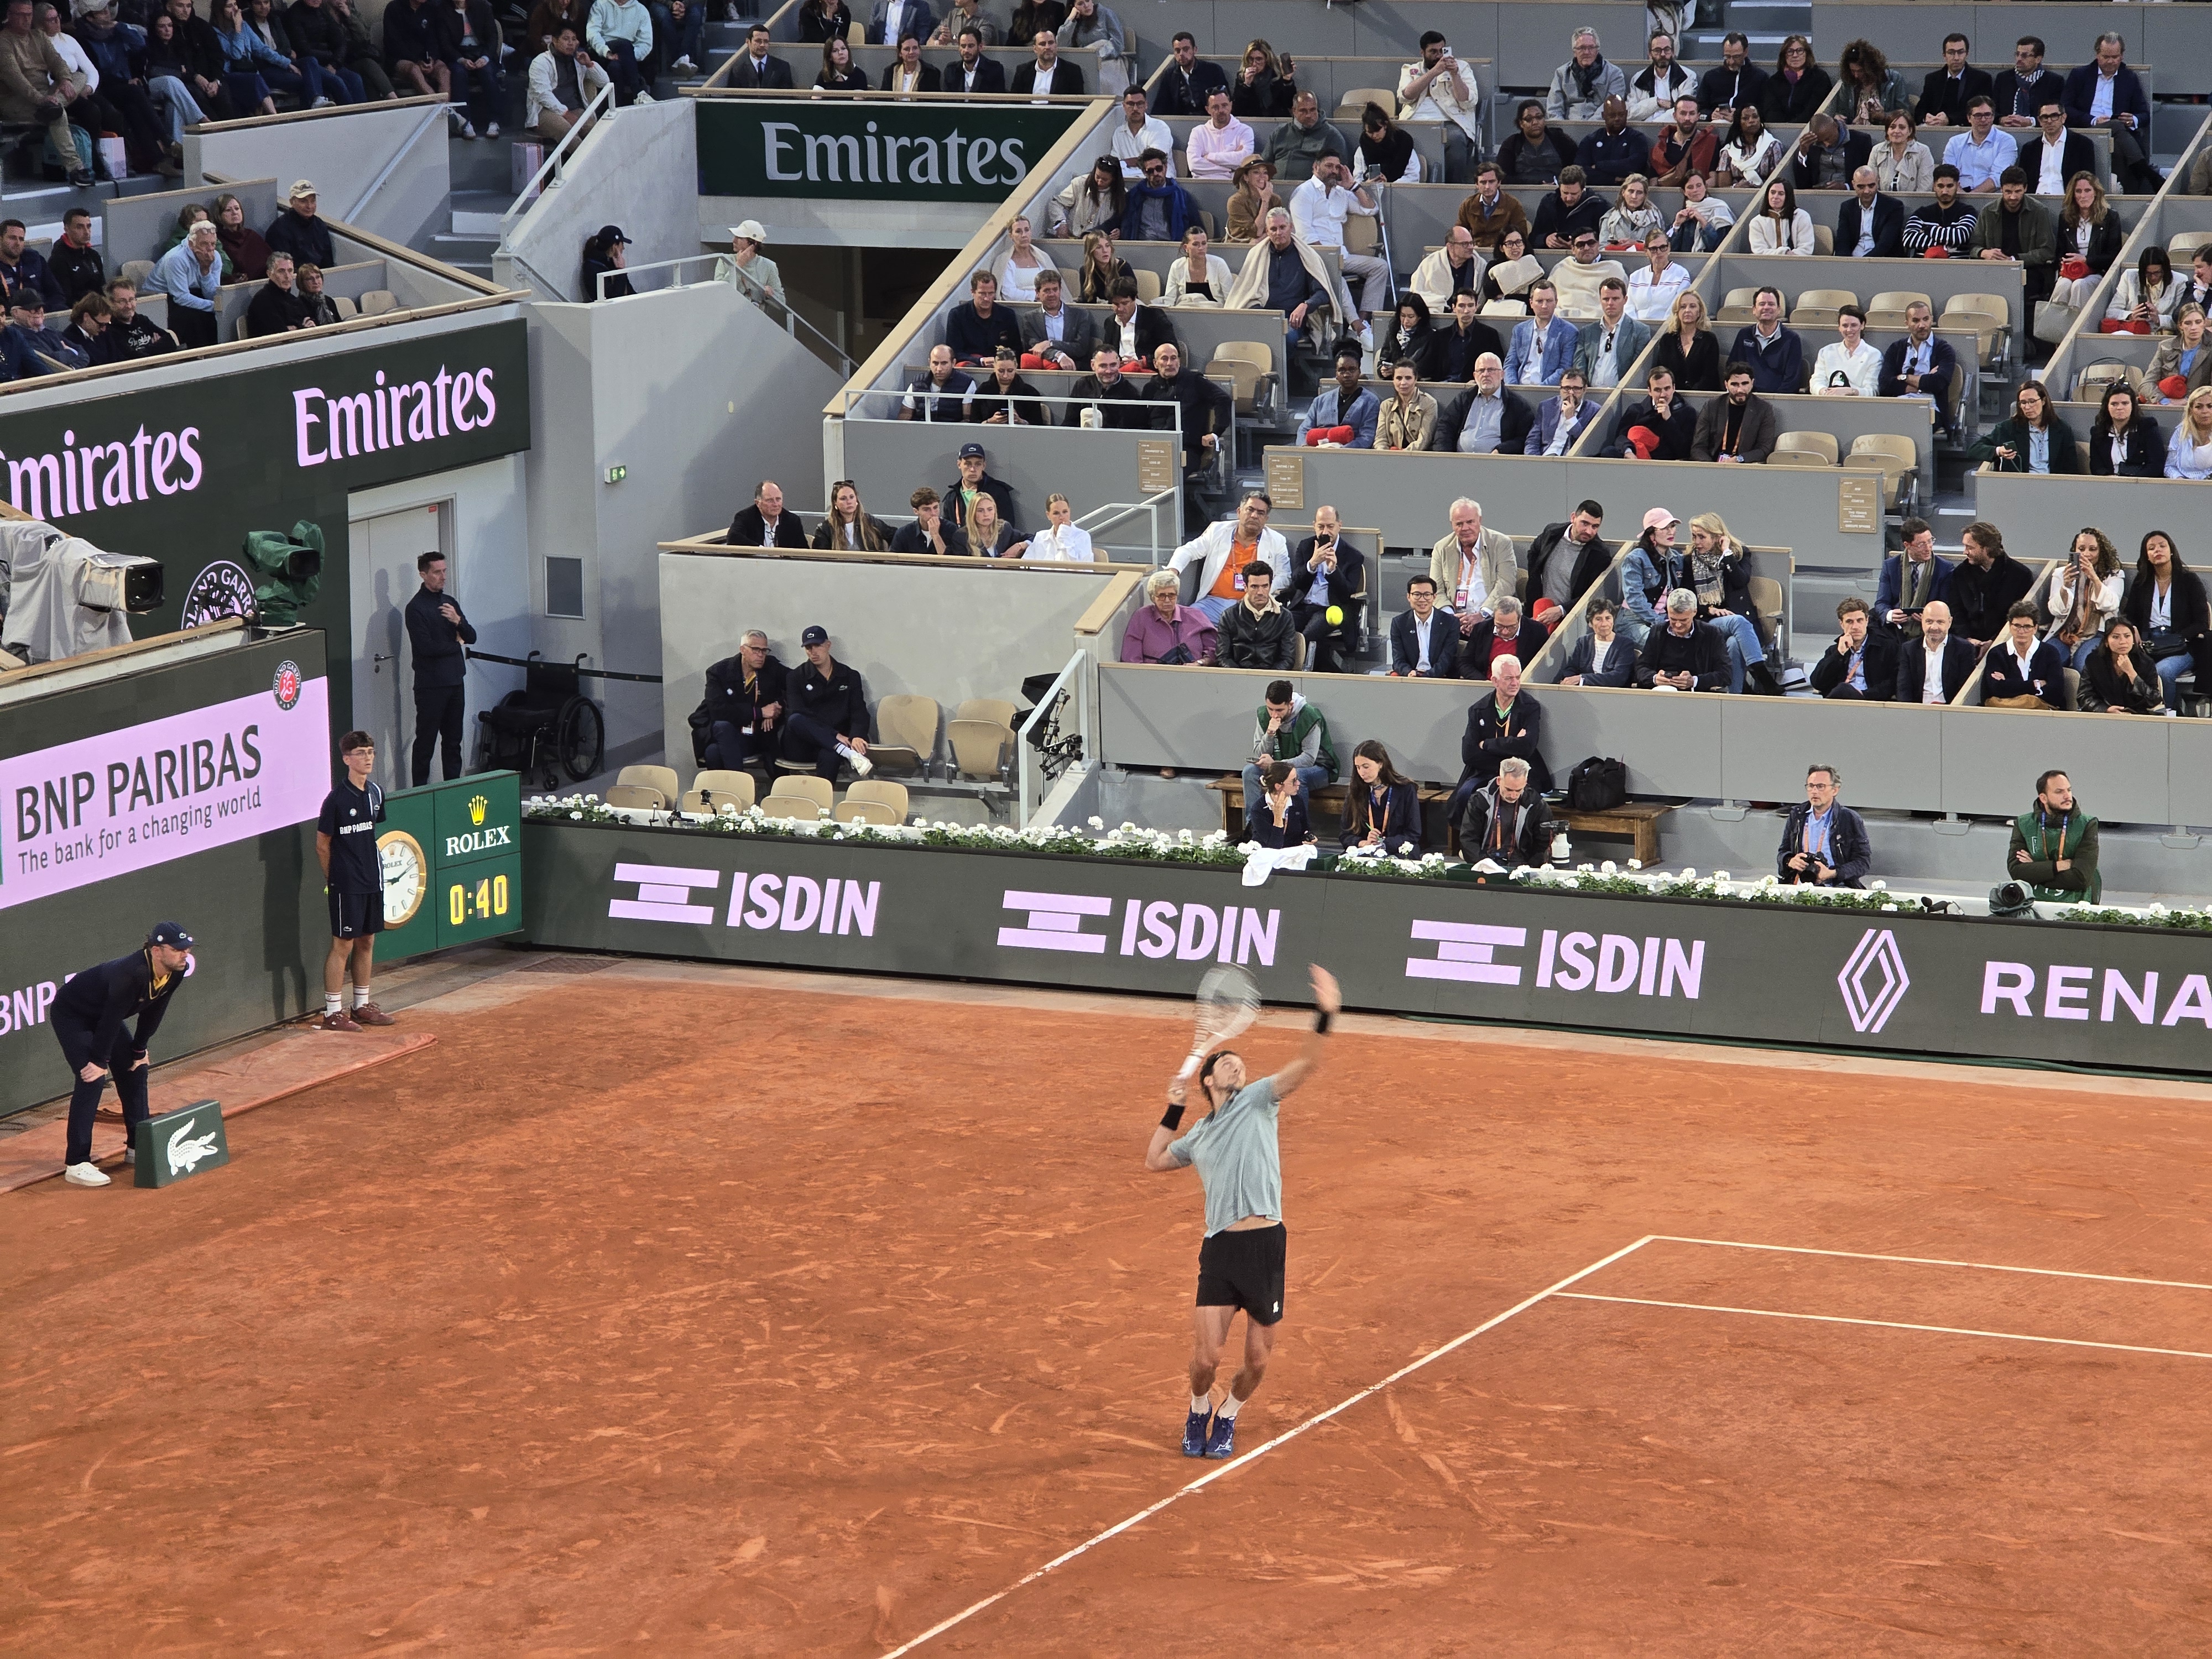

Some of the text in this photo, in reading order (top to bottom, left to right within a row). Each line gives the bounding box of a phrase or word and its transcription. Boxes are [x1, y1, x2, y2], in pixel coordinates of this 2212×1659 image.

[760, 121, 1026, 185] Emirates
[293, 364, 495, 467] Emirates
[0, 424, 202, 521] mirates
[16, 724, 262, 842] BNP PARIBAS
[19, 785, 262, 874] The bank for a changing world
[340, 821, 373, 834] BNP PARIBAS
[446, 826, 512, 856] ROLEX
[383, 860, 403, 869] ROLEX
[450, 875, 508, 925] 0:40
[727, 872, 880, 937] ISDIN
[1120, 899, 1280, 966] ISDIN
[1536, 930, 1705, 999] ISDIN
[1980, 961, 2212, 1029] RENA
